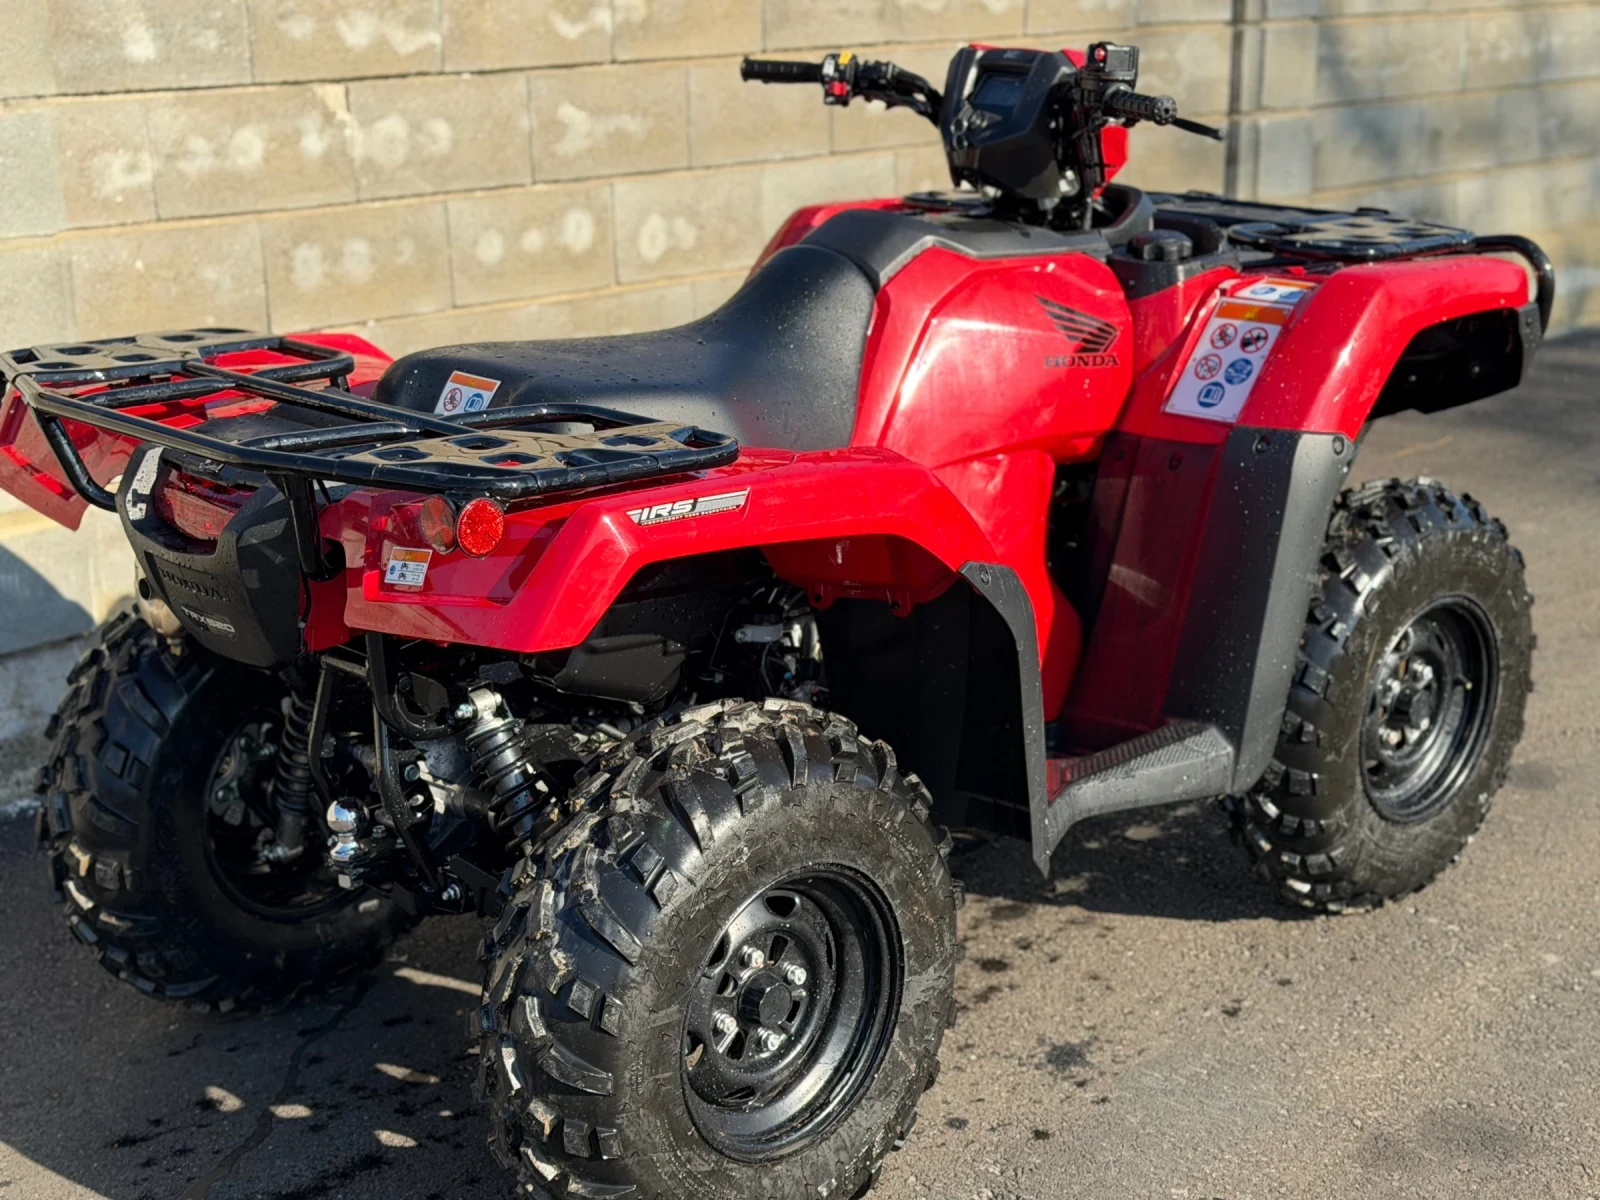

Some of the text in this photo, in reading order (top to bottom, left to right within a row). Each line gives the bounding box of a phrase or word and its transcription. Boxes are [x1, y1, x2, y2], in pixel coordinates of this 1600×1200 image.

[1044, 355, 1119, 367] HONDA
[641, 499, 694, 520] IRS
[158, 565, 231, 602] HONDA
[181, 606, 235, 633] TRX520
